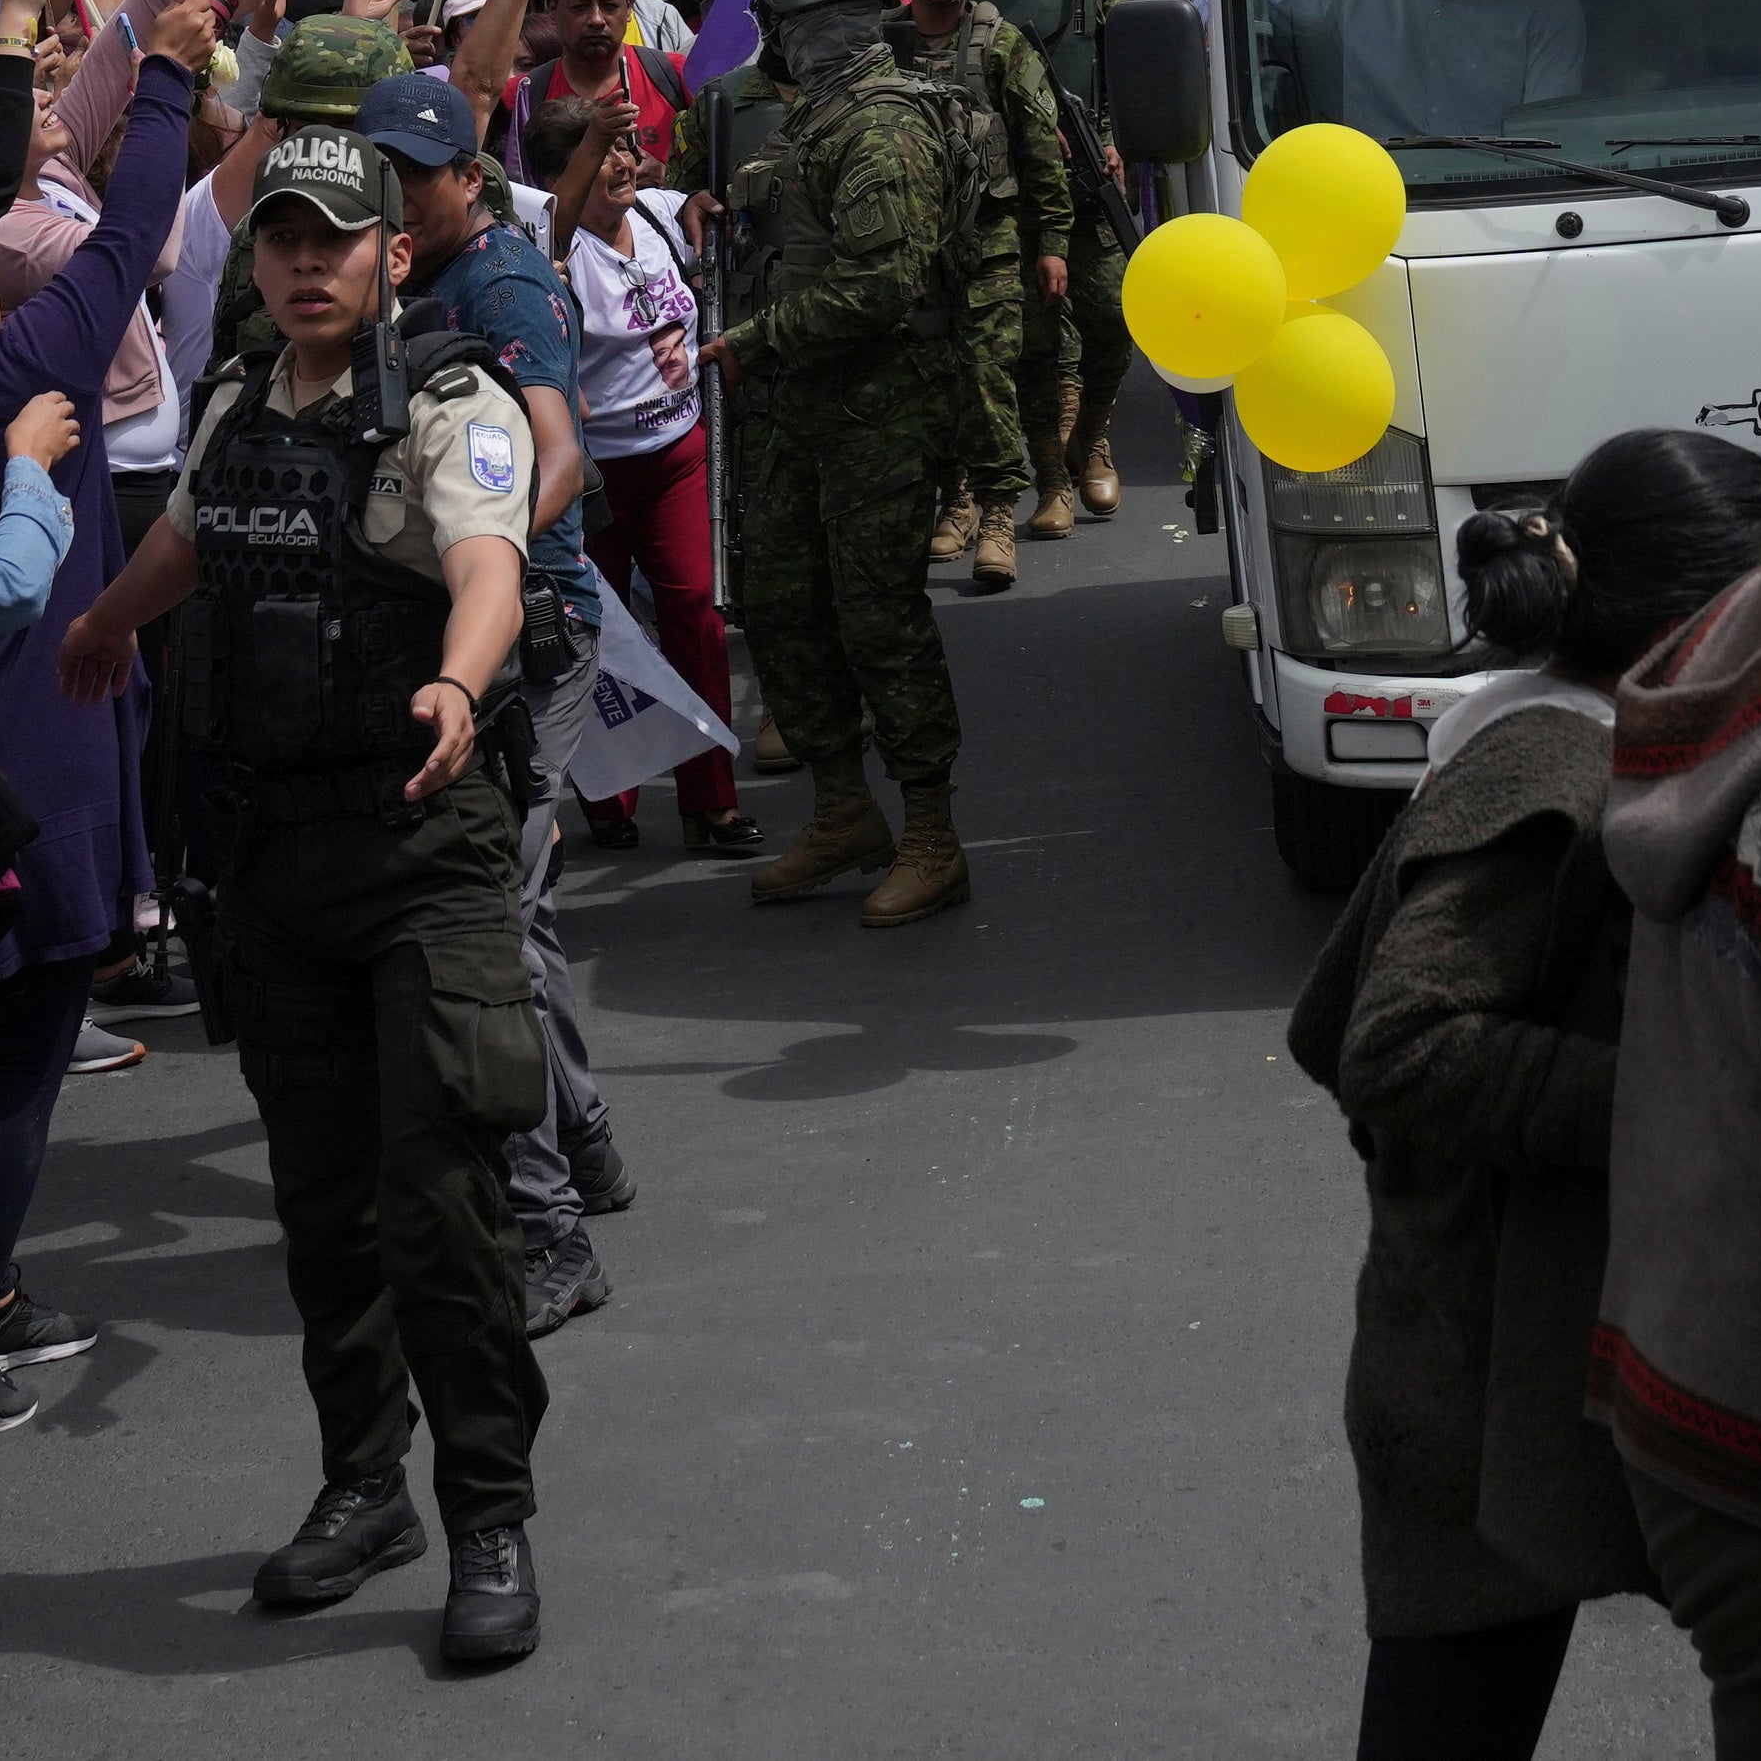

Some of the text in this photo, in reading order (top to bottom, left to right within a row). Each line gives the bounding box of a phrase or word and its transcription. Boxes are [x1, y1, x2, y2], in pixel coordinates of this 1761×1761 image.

[291, 167, 365, 194] NACIONAL
[634, 395, 671, 412] DANIEL
[196, 505, 319, 536] POLICIA
[247, 533, 319, 547] ECUADOR
[1417, 699, 1431, 708] 3M
